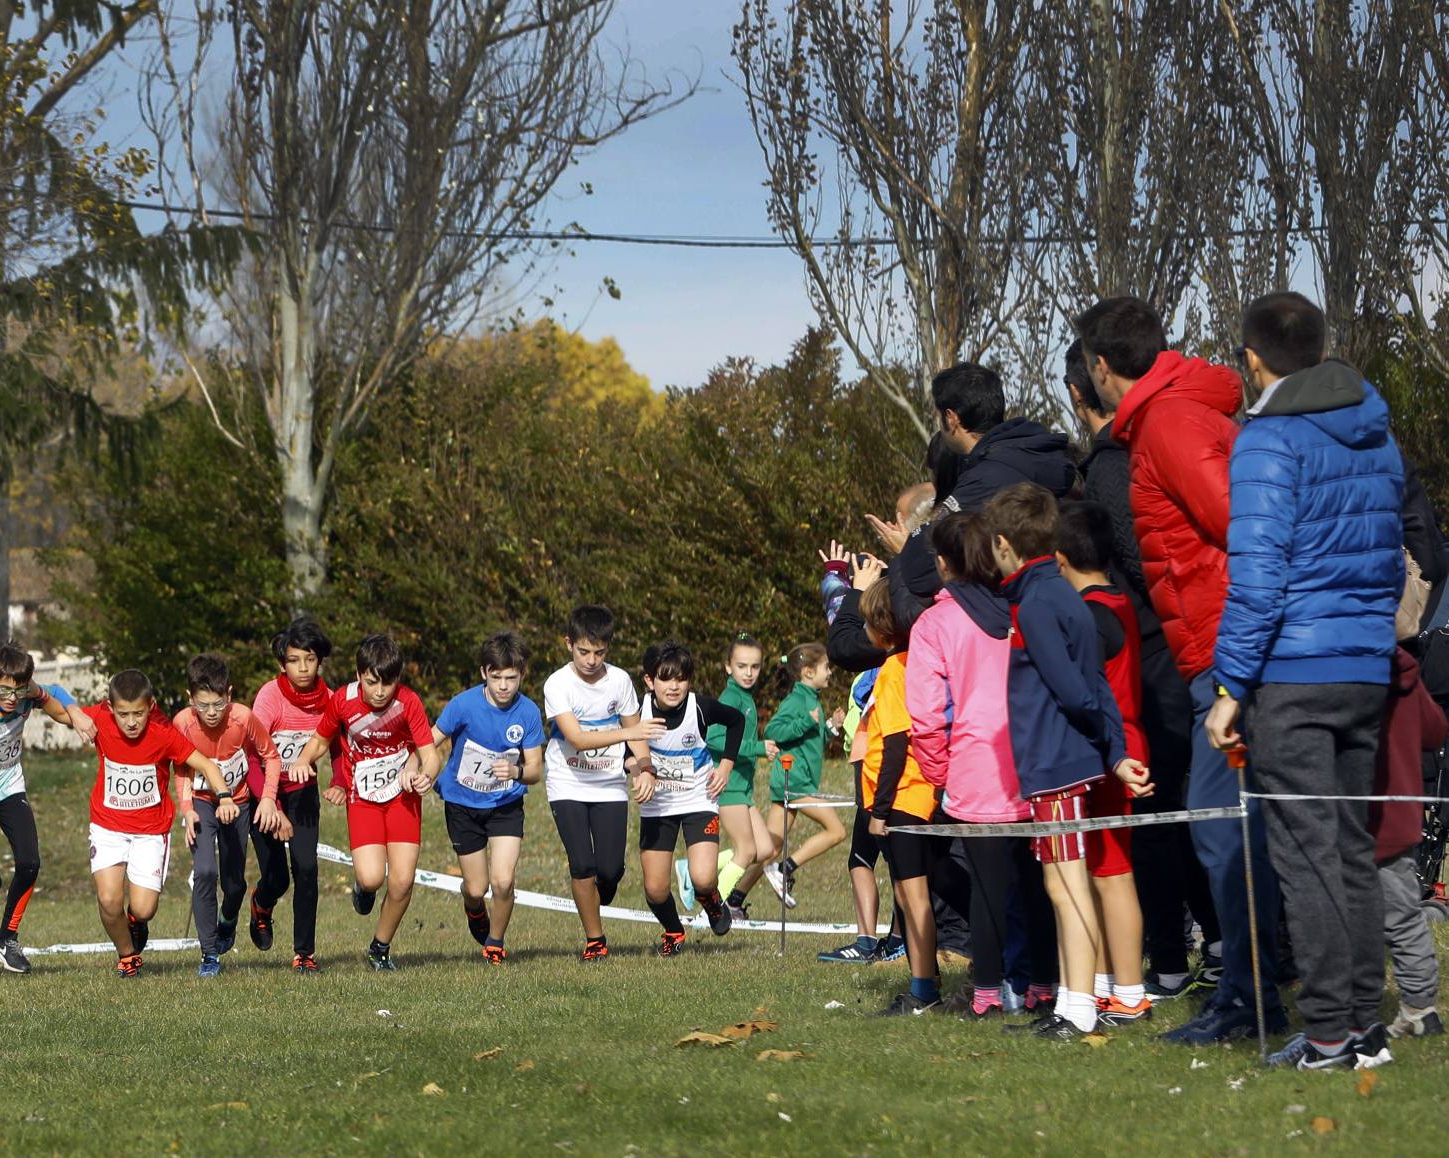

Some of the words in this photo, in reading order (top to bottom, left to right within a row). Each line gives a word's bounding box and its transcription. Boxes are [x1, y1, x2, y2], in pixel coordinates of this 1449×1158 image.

[198, 762, 246, 789] 194
[107, 776, 154, 796] 1606
[120, 795, 156, 807] ATLETISMO
